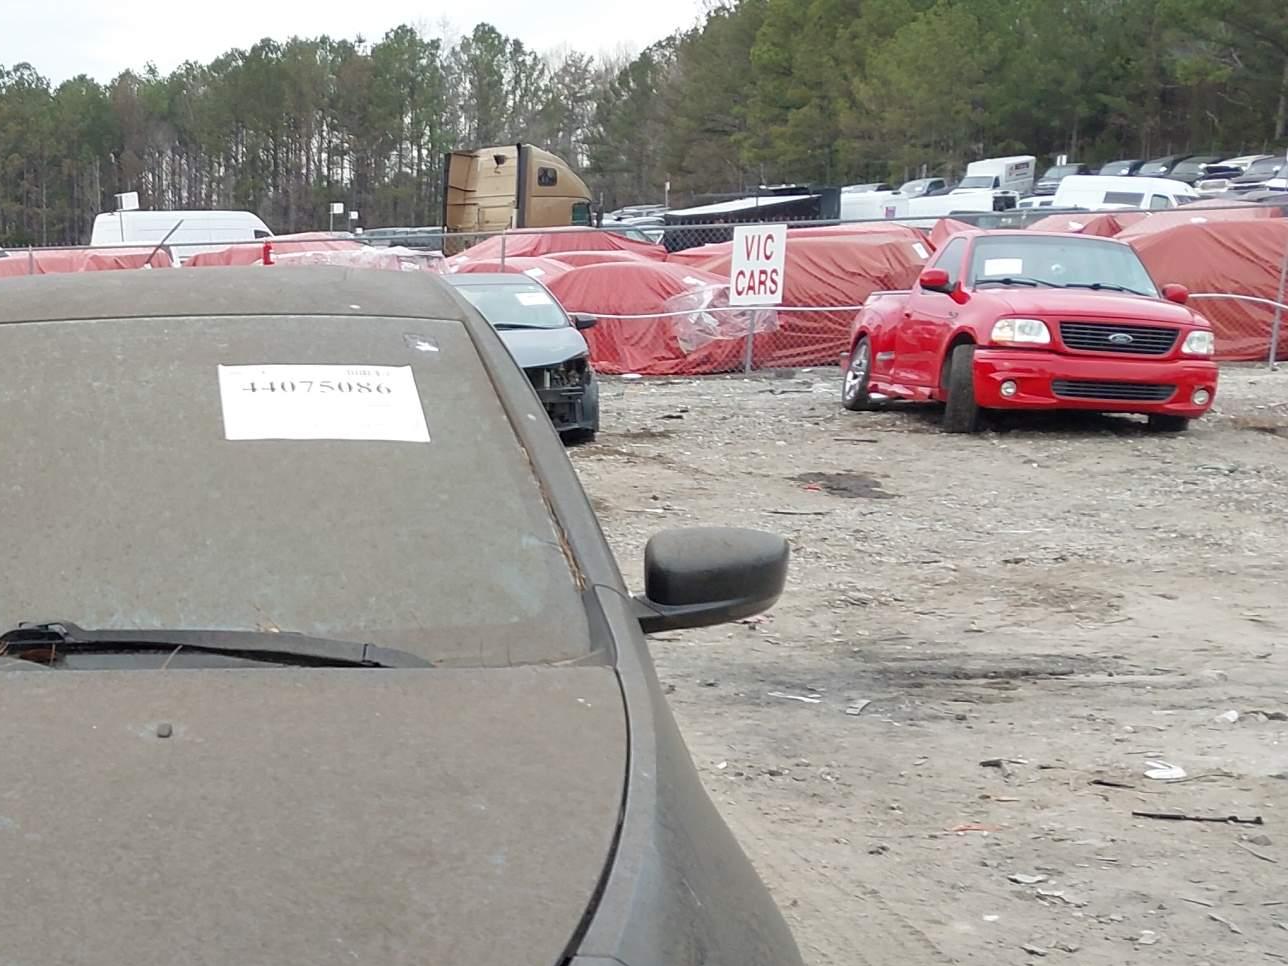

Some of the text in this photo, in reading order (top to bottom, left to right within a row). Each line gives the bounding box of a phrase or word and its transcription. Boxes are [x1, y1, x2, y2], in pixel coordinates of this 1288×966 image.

[745, 234, 775, 261] VIC
[735, 268, 779, 296] CARS
[241, 380, 393, 394] 44075086
